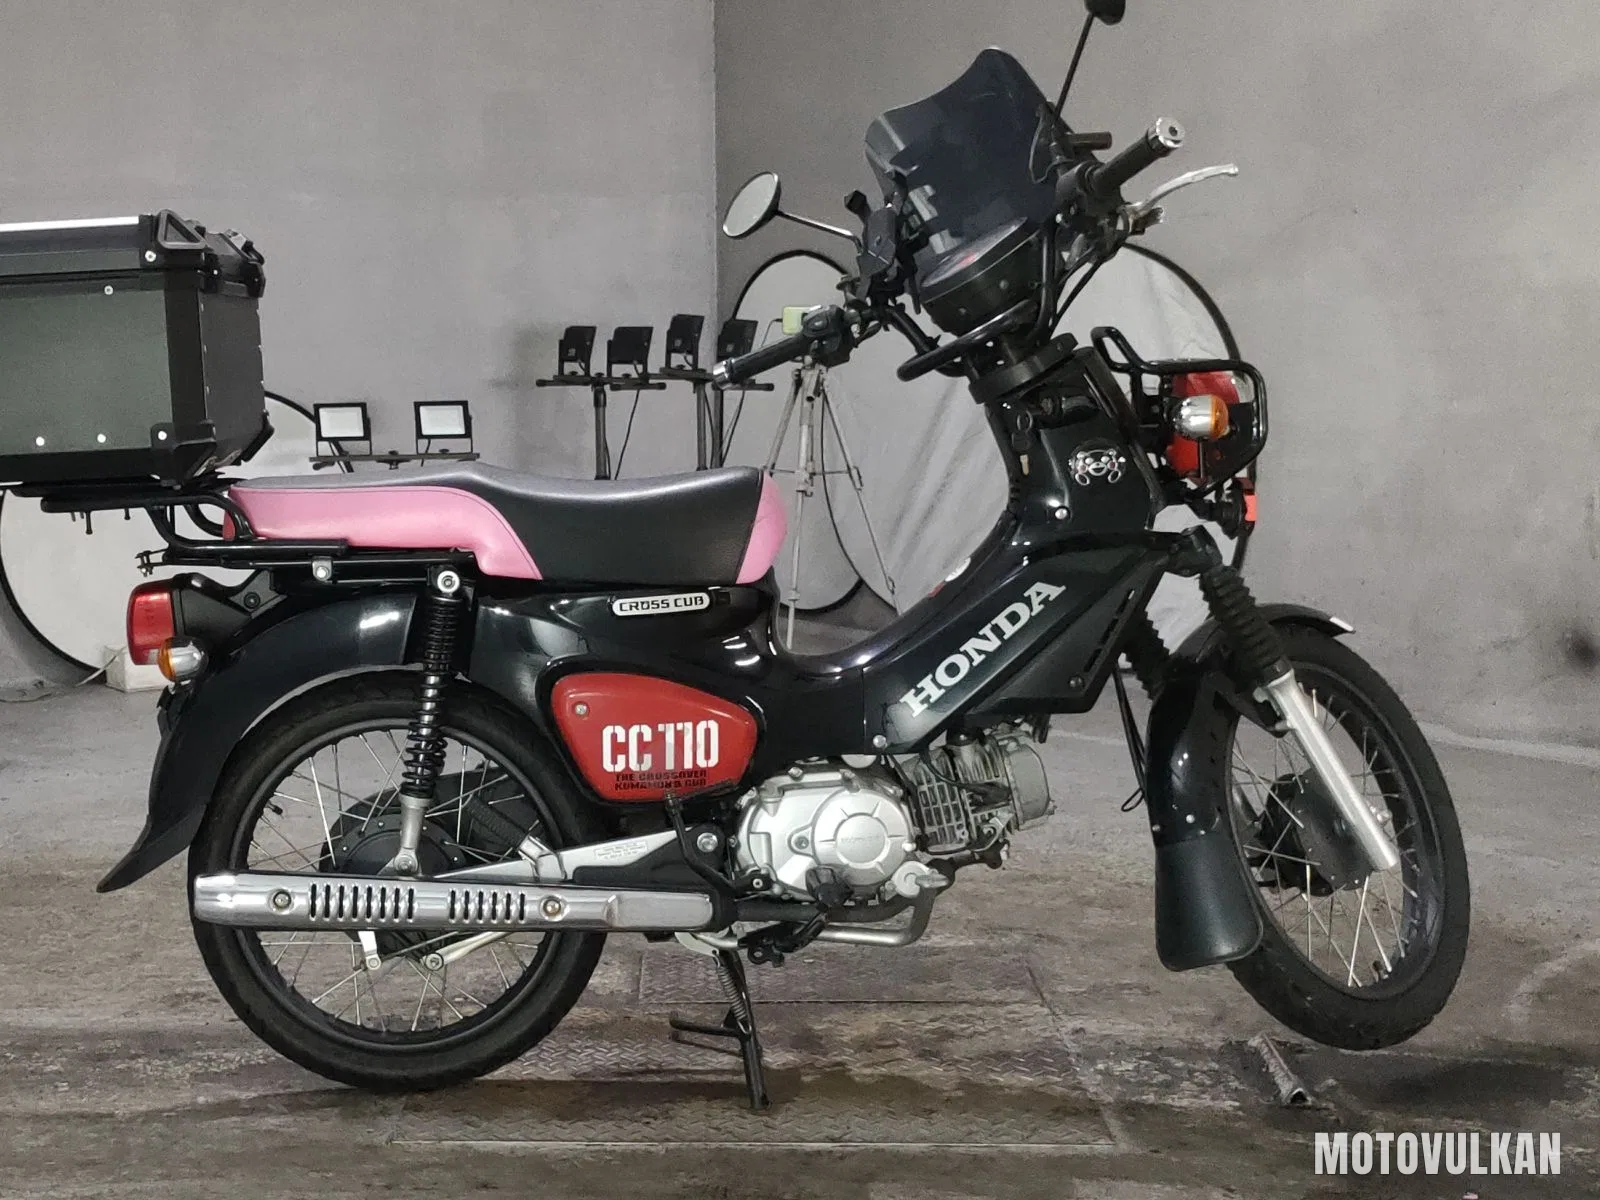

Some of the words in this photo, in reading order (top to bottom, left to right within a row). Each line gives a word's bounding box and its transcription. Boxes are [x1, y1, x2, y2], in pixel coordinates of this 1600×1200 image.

[619, 599, 670, 612] CROSS
[674, 596, 704, 608] CUB
[899, 581, 1067, 718] HONDA
[602, 724, 652, 773] CC
[658, 720, 719, 771] 110
[615, 773, 635, 782] THE
